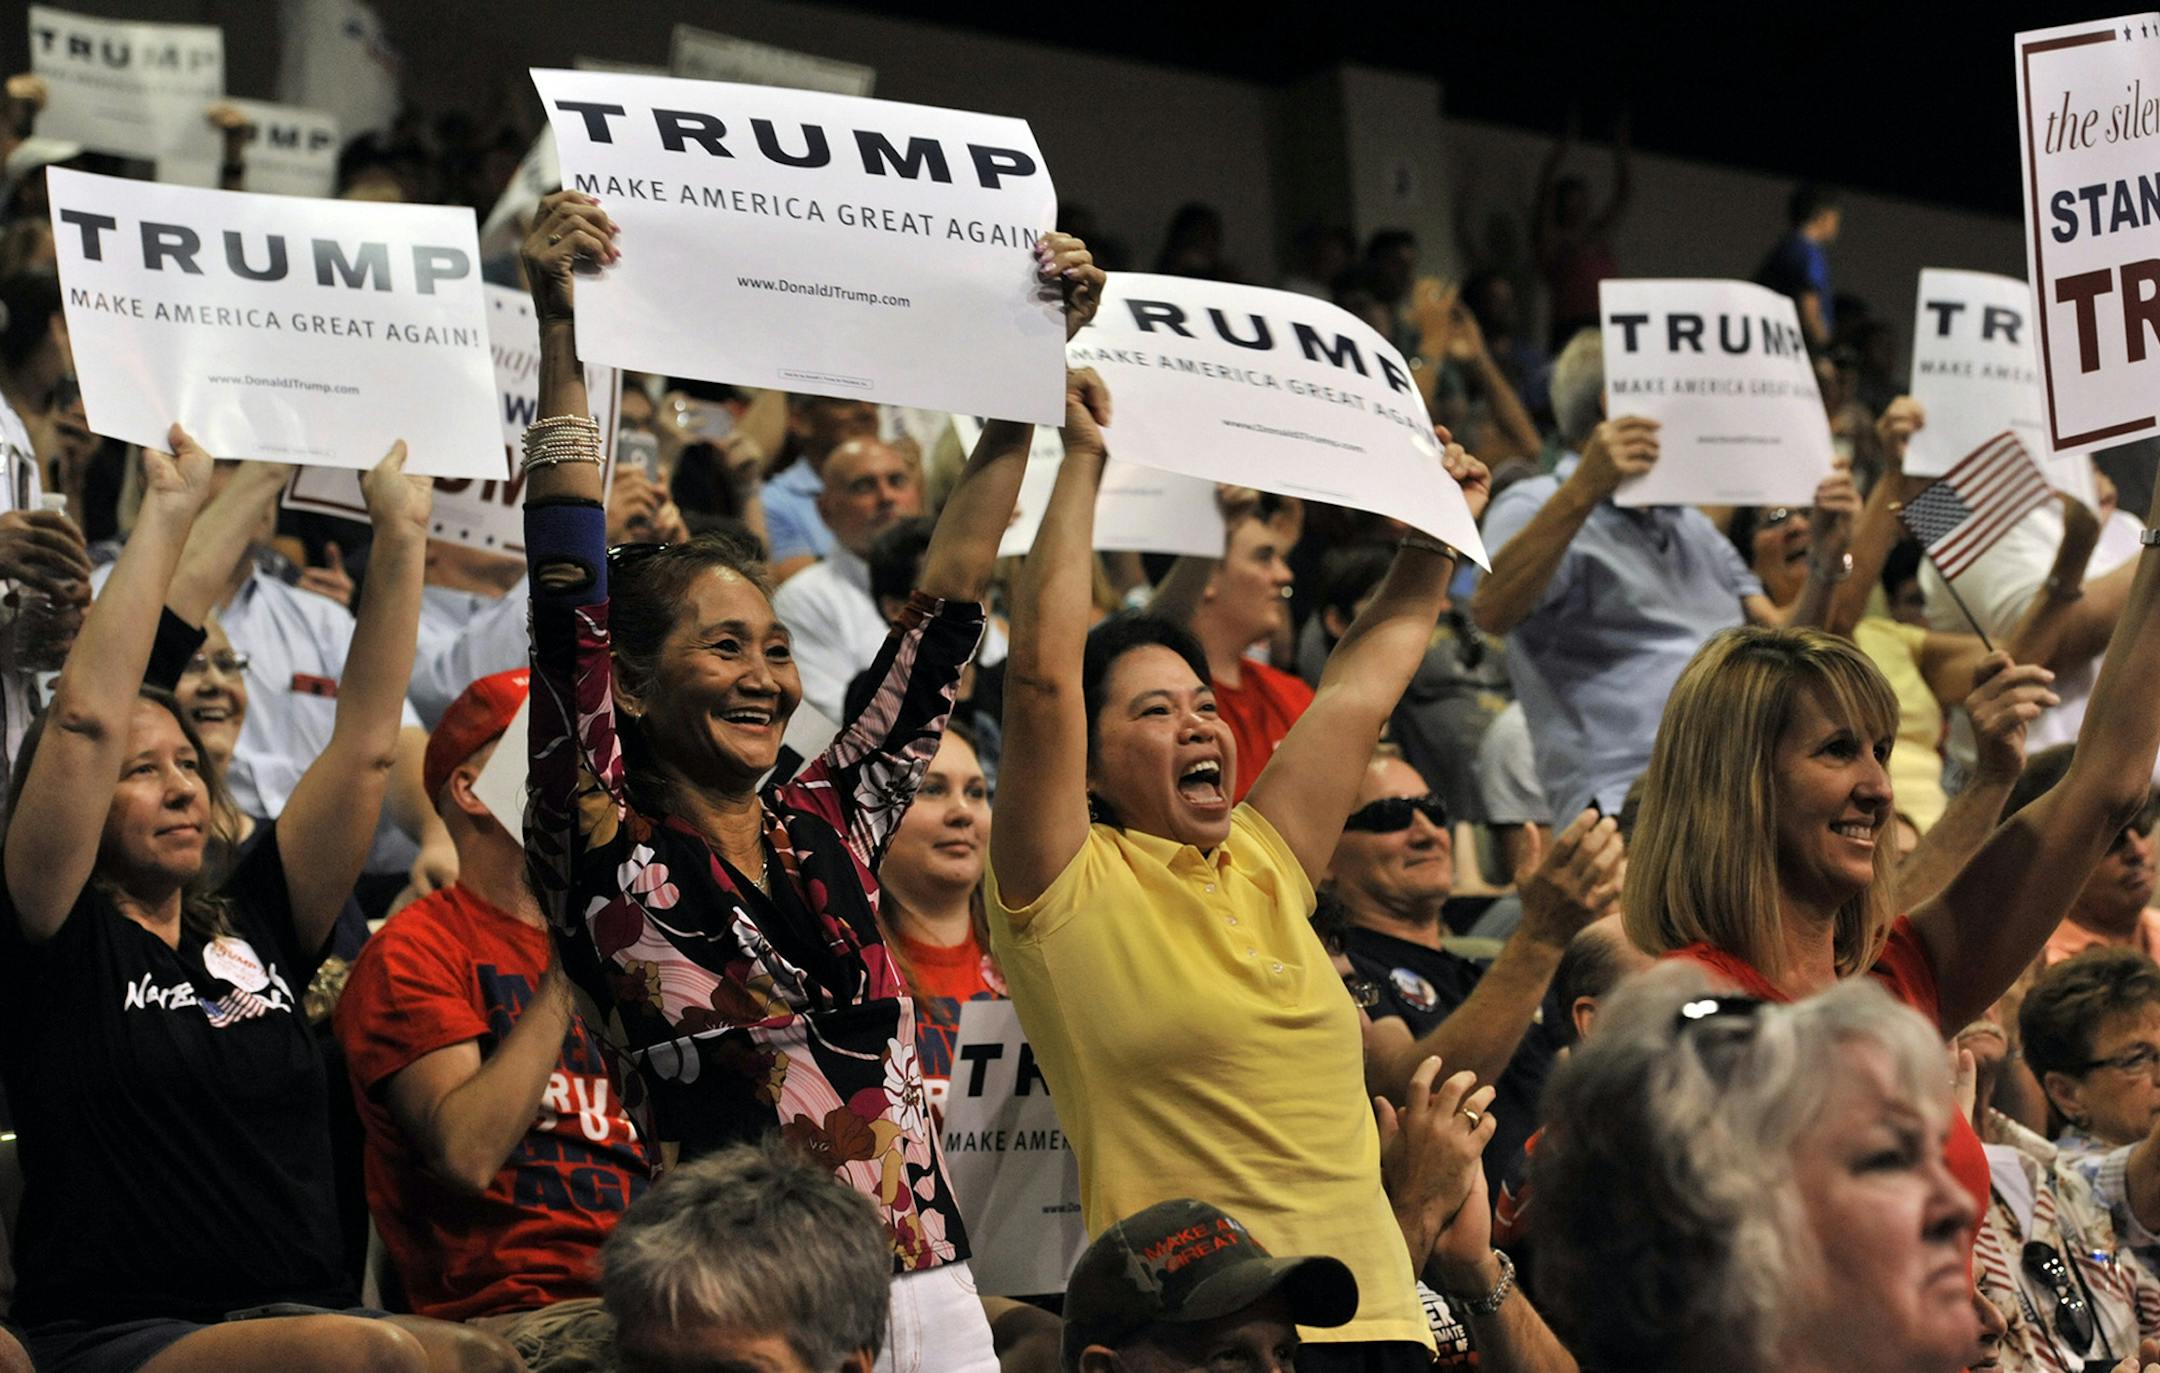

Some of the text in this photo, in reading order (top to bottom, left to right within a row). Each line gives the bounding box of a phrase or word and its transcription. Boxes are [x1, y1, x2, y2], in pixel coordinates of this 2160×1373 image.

[554, 99, 1037, 190] TRUMP
[2045, 91, 2098, 155] the
[575, 173, 1040, 250] MAKE AMERICA GREAT AGAIN
[60, 208, 471, 296] TRUMP
[70, 287, 481, 348] MAKE AMERICA GREAT AGAIN!
[737, 276, 911, 308] www.DonaldJTrump.com
[1086, 298, 1412, 395] RUMP
[208, 374, 360, 395] www.DonaldJTrump.com
[1070, 348, 1151, 367] MAKE
[1157, 354, 1281, 391] AMERICA
[1288, 378, 1366, 412] GREAT
[945, 1132, 1007, 1152] MAKE
[1142, 1222, 1209, 1262] MAKE
[1165, 1233, 1238, 1273] GREAT
